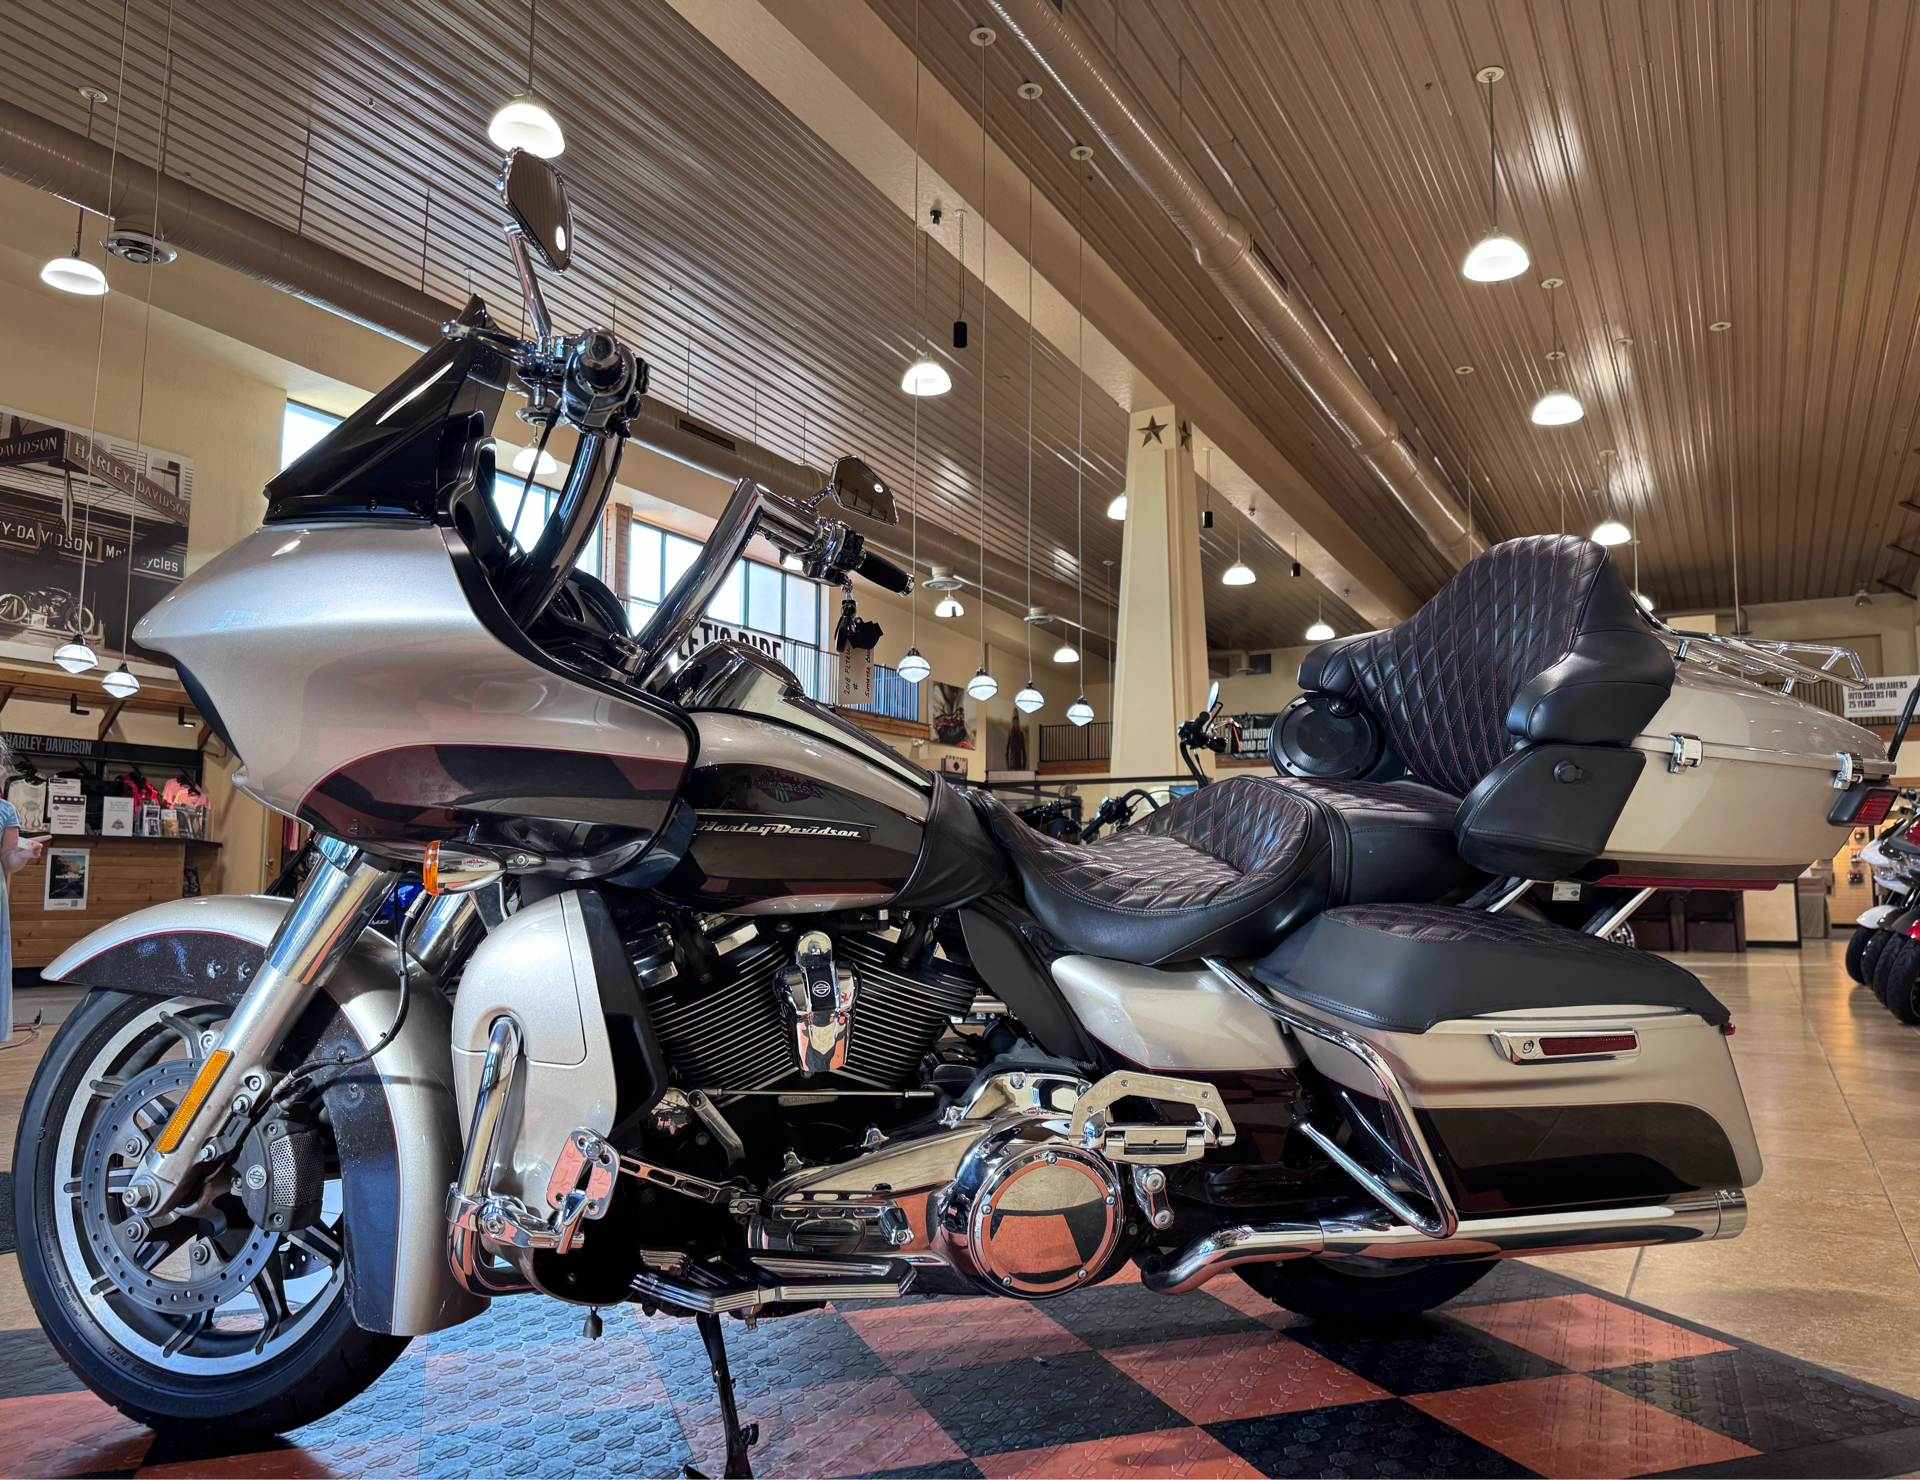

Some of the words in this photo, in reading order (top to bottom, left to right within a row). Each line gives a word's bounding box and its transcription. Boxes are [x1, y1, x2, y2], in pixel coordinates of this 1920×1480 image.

[74, 441, 190, 519] HARLEY-DAVIDSON
[0, 521, 94, 554] Y-DAVIDSON
[105, 544, 179, 573] Mocycles
[843, 676, 851, 695] 2018
[1848, 692, 1862, 700] INTO
[1863, 690, 1884, 699] RIDERS
[1885, 690, 1897, 698] FOR
[1875, 681, 1907, 690] DREAMERS
[1857, 700, 1876, 708] YEARS
[4, 732, 93, 755] HARLEY-DAVIDSON
